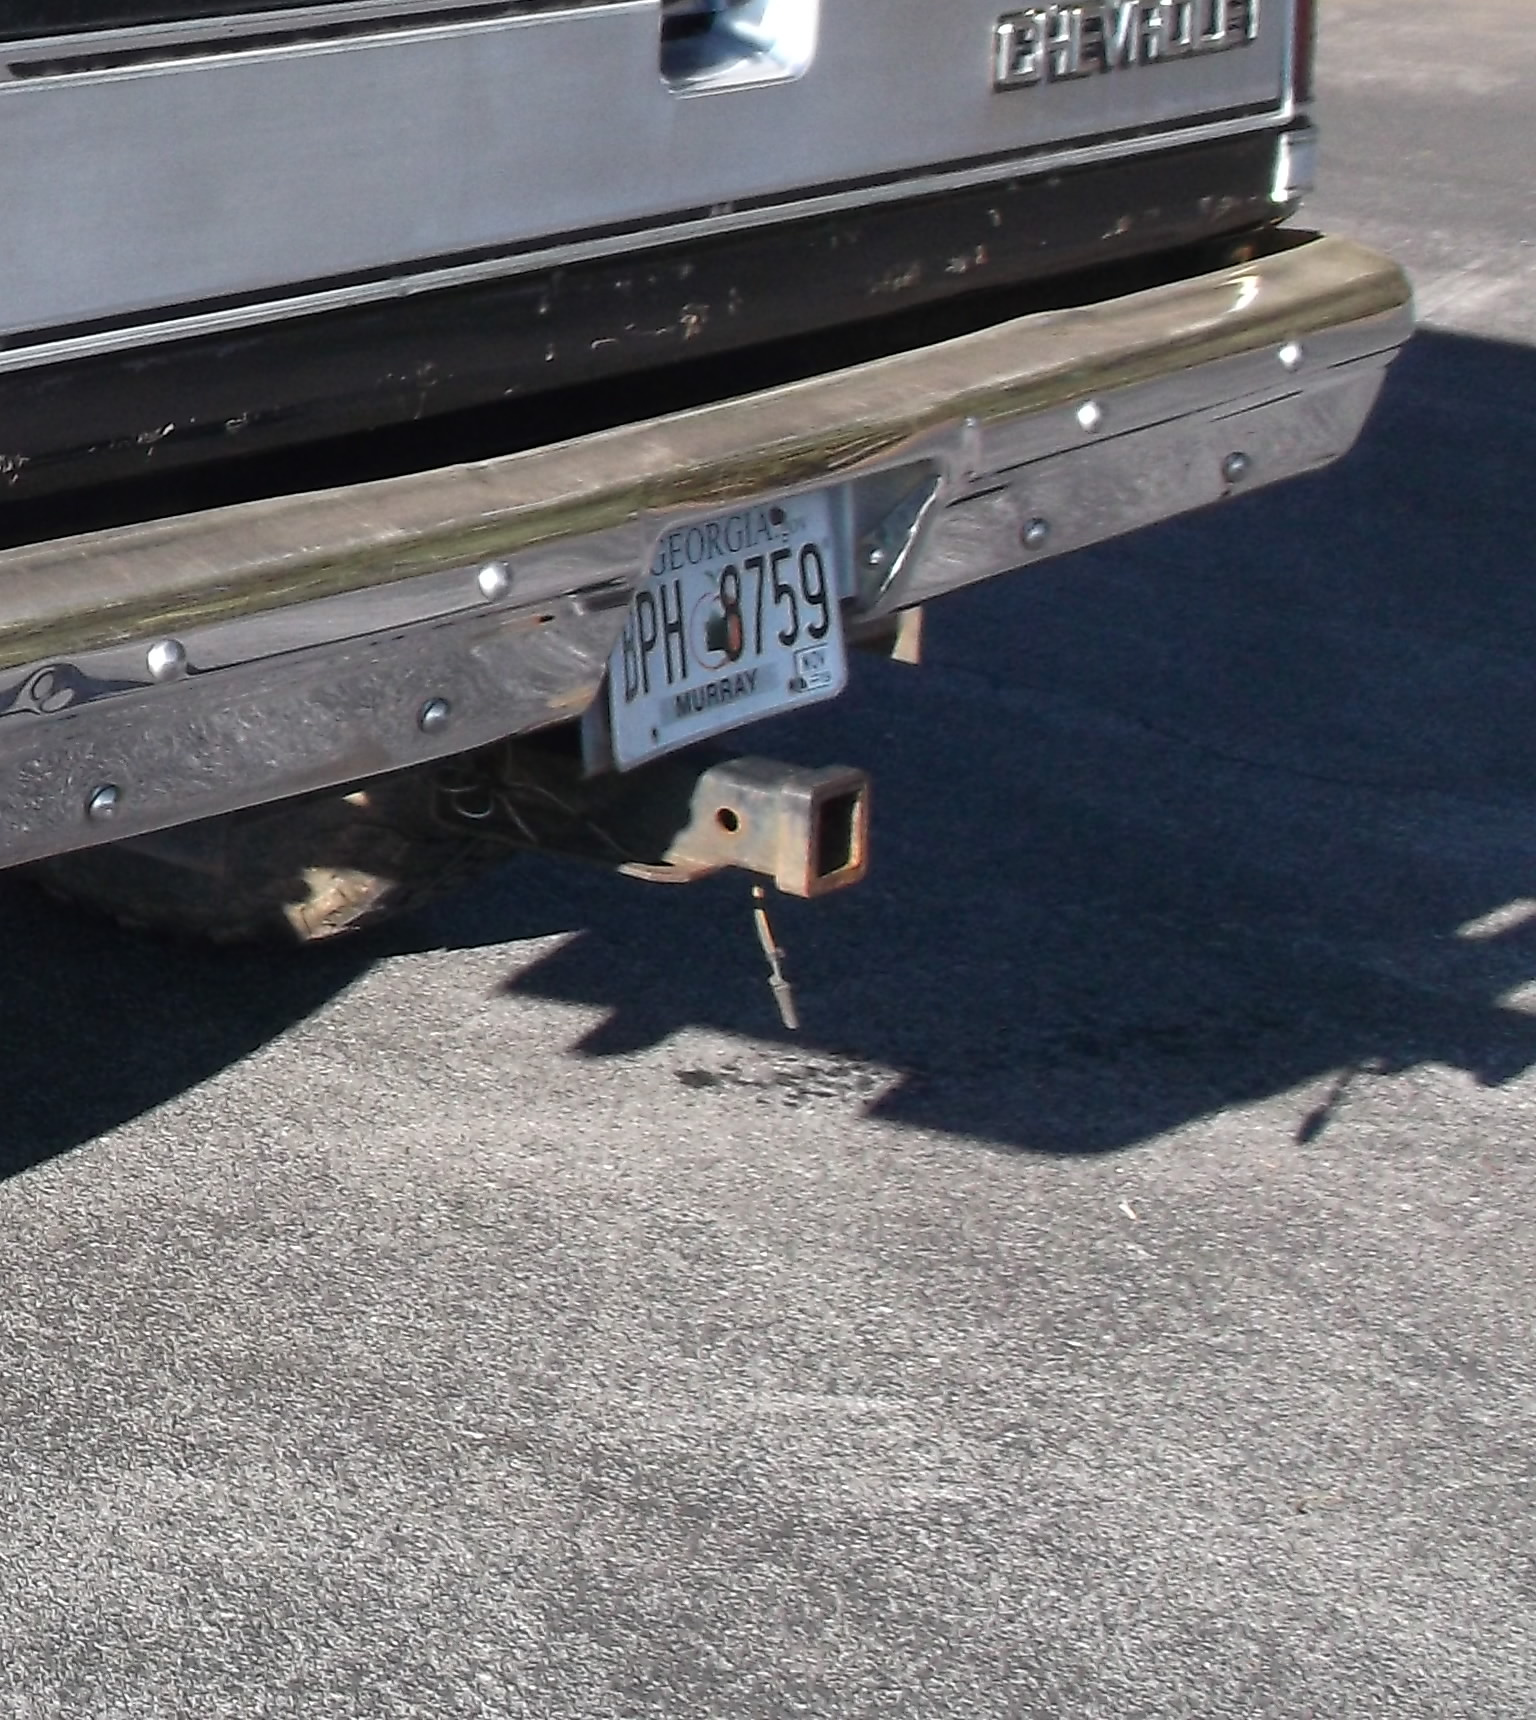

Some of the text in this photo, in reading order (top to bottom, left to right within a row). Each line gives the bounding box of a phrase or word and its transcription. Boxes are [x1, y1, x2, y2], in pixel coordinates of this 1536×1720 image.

[650, 511, 773, 576] GEORGIA
[719, 541, 831, 662] 8759
[675, 667, 759, 718] MURRAY
